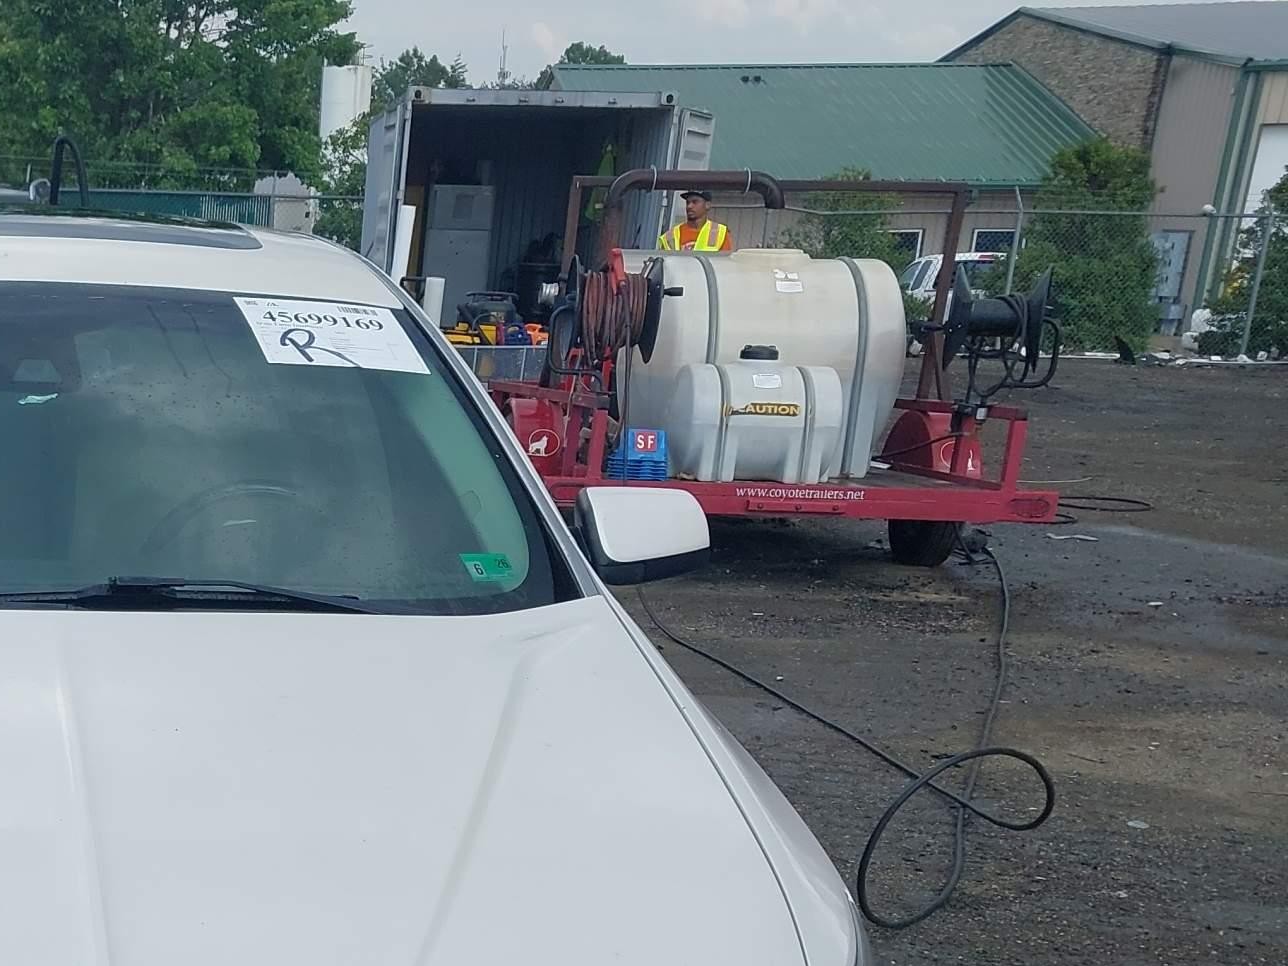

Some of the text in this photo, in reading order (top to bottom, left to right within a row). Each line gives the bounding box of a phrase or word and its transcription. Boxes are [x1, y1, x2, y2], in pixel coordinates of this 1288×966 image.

[263, 310, 384, 331] 45699169
[735, 487, 865, 502] www.coyotetrailers.net
[473, 563, 484, 576] 6
